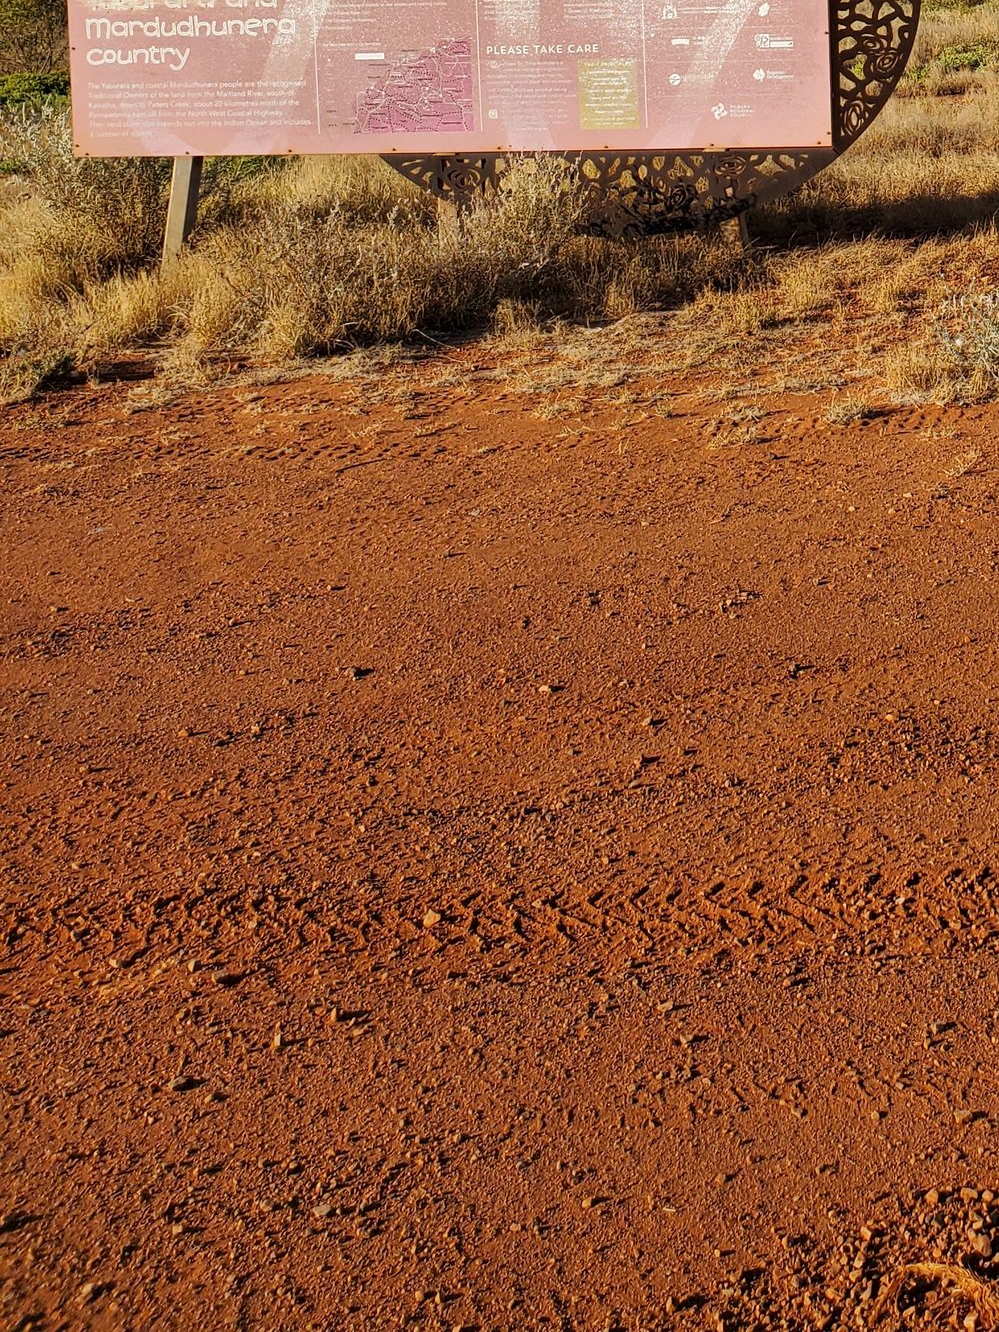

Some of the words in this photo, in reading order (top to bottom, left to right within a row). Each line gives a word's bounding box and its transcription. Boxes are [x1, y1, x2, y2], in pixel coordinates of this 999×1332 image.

[85, 15, 297, 39] Mardudhunera
[486, 44, 529, 55] PLEASE
[533, 44, 563, 54] TAKE
[567, 43, 599, 54] CARE
